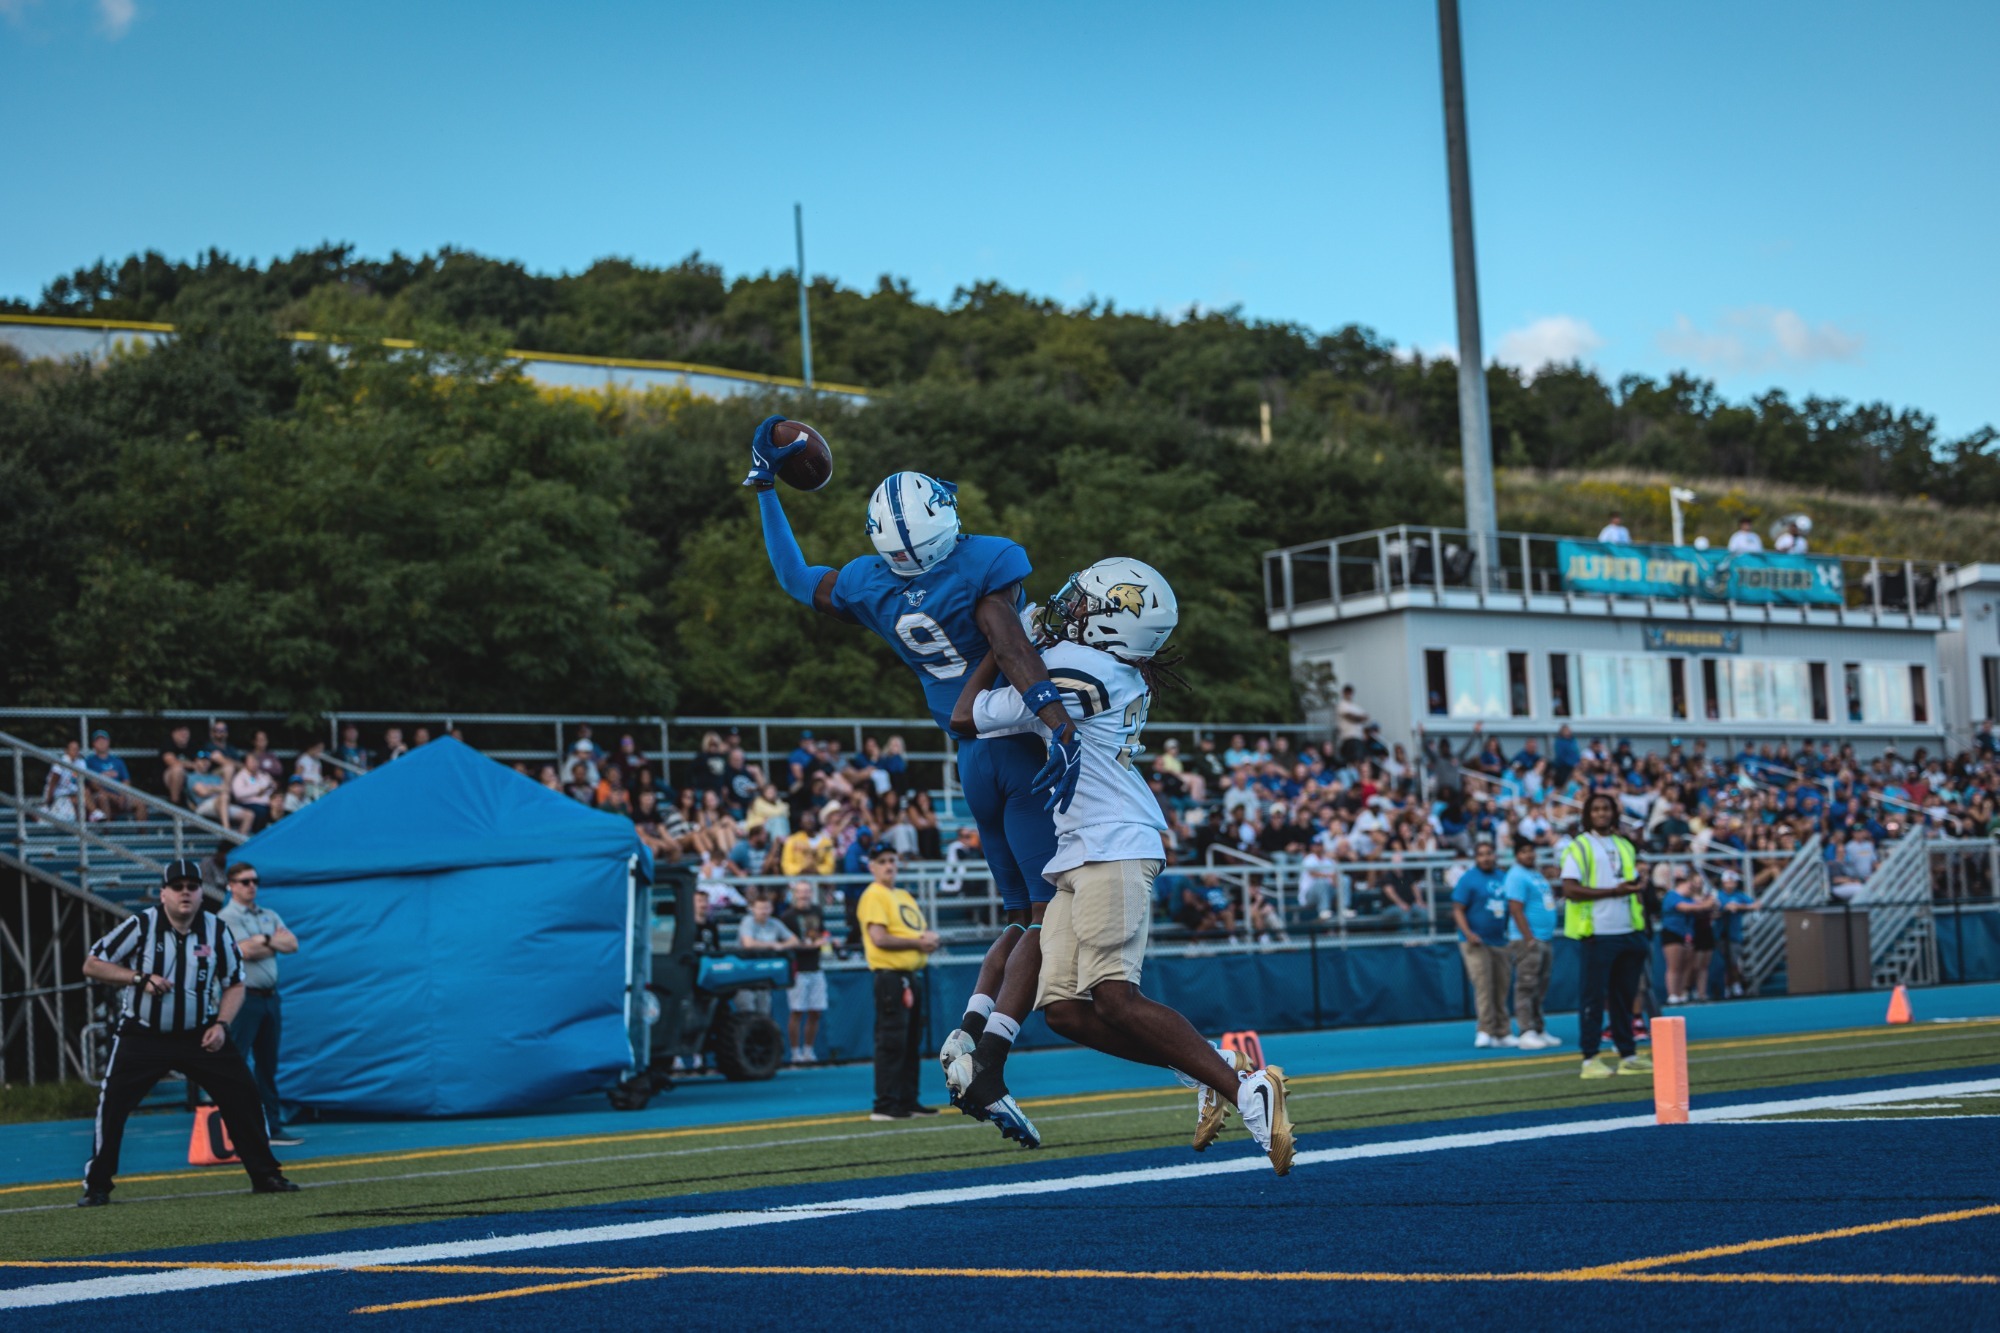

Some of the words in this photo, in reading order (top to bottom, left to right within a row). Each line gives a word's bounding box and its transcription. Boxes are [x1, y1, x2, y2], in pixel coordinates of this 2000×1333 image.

[895, 612, 968, 680] 9
[156, 942, 164, 953] S
[198, 969, 207, 981] S
